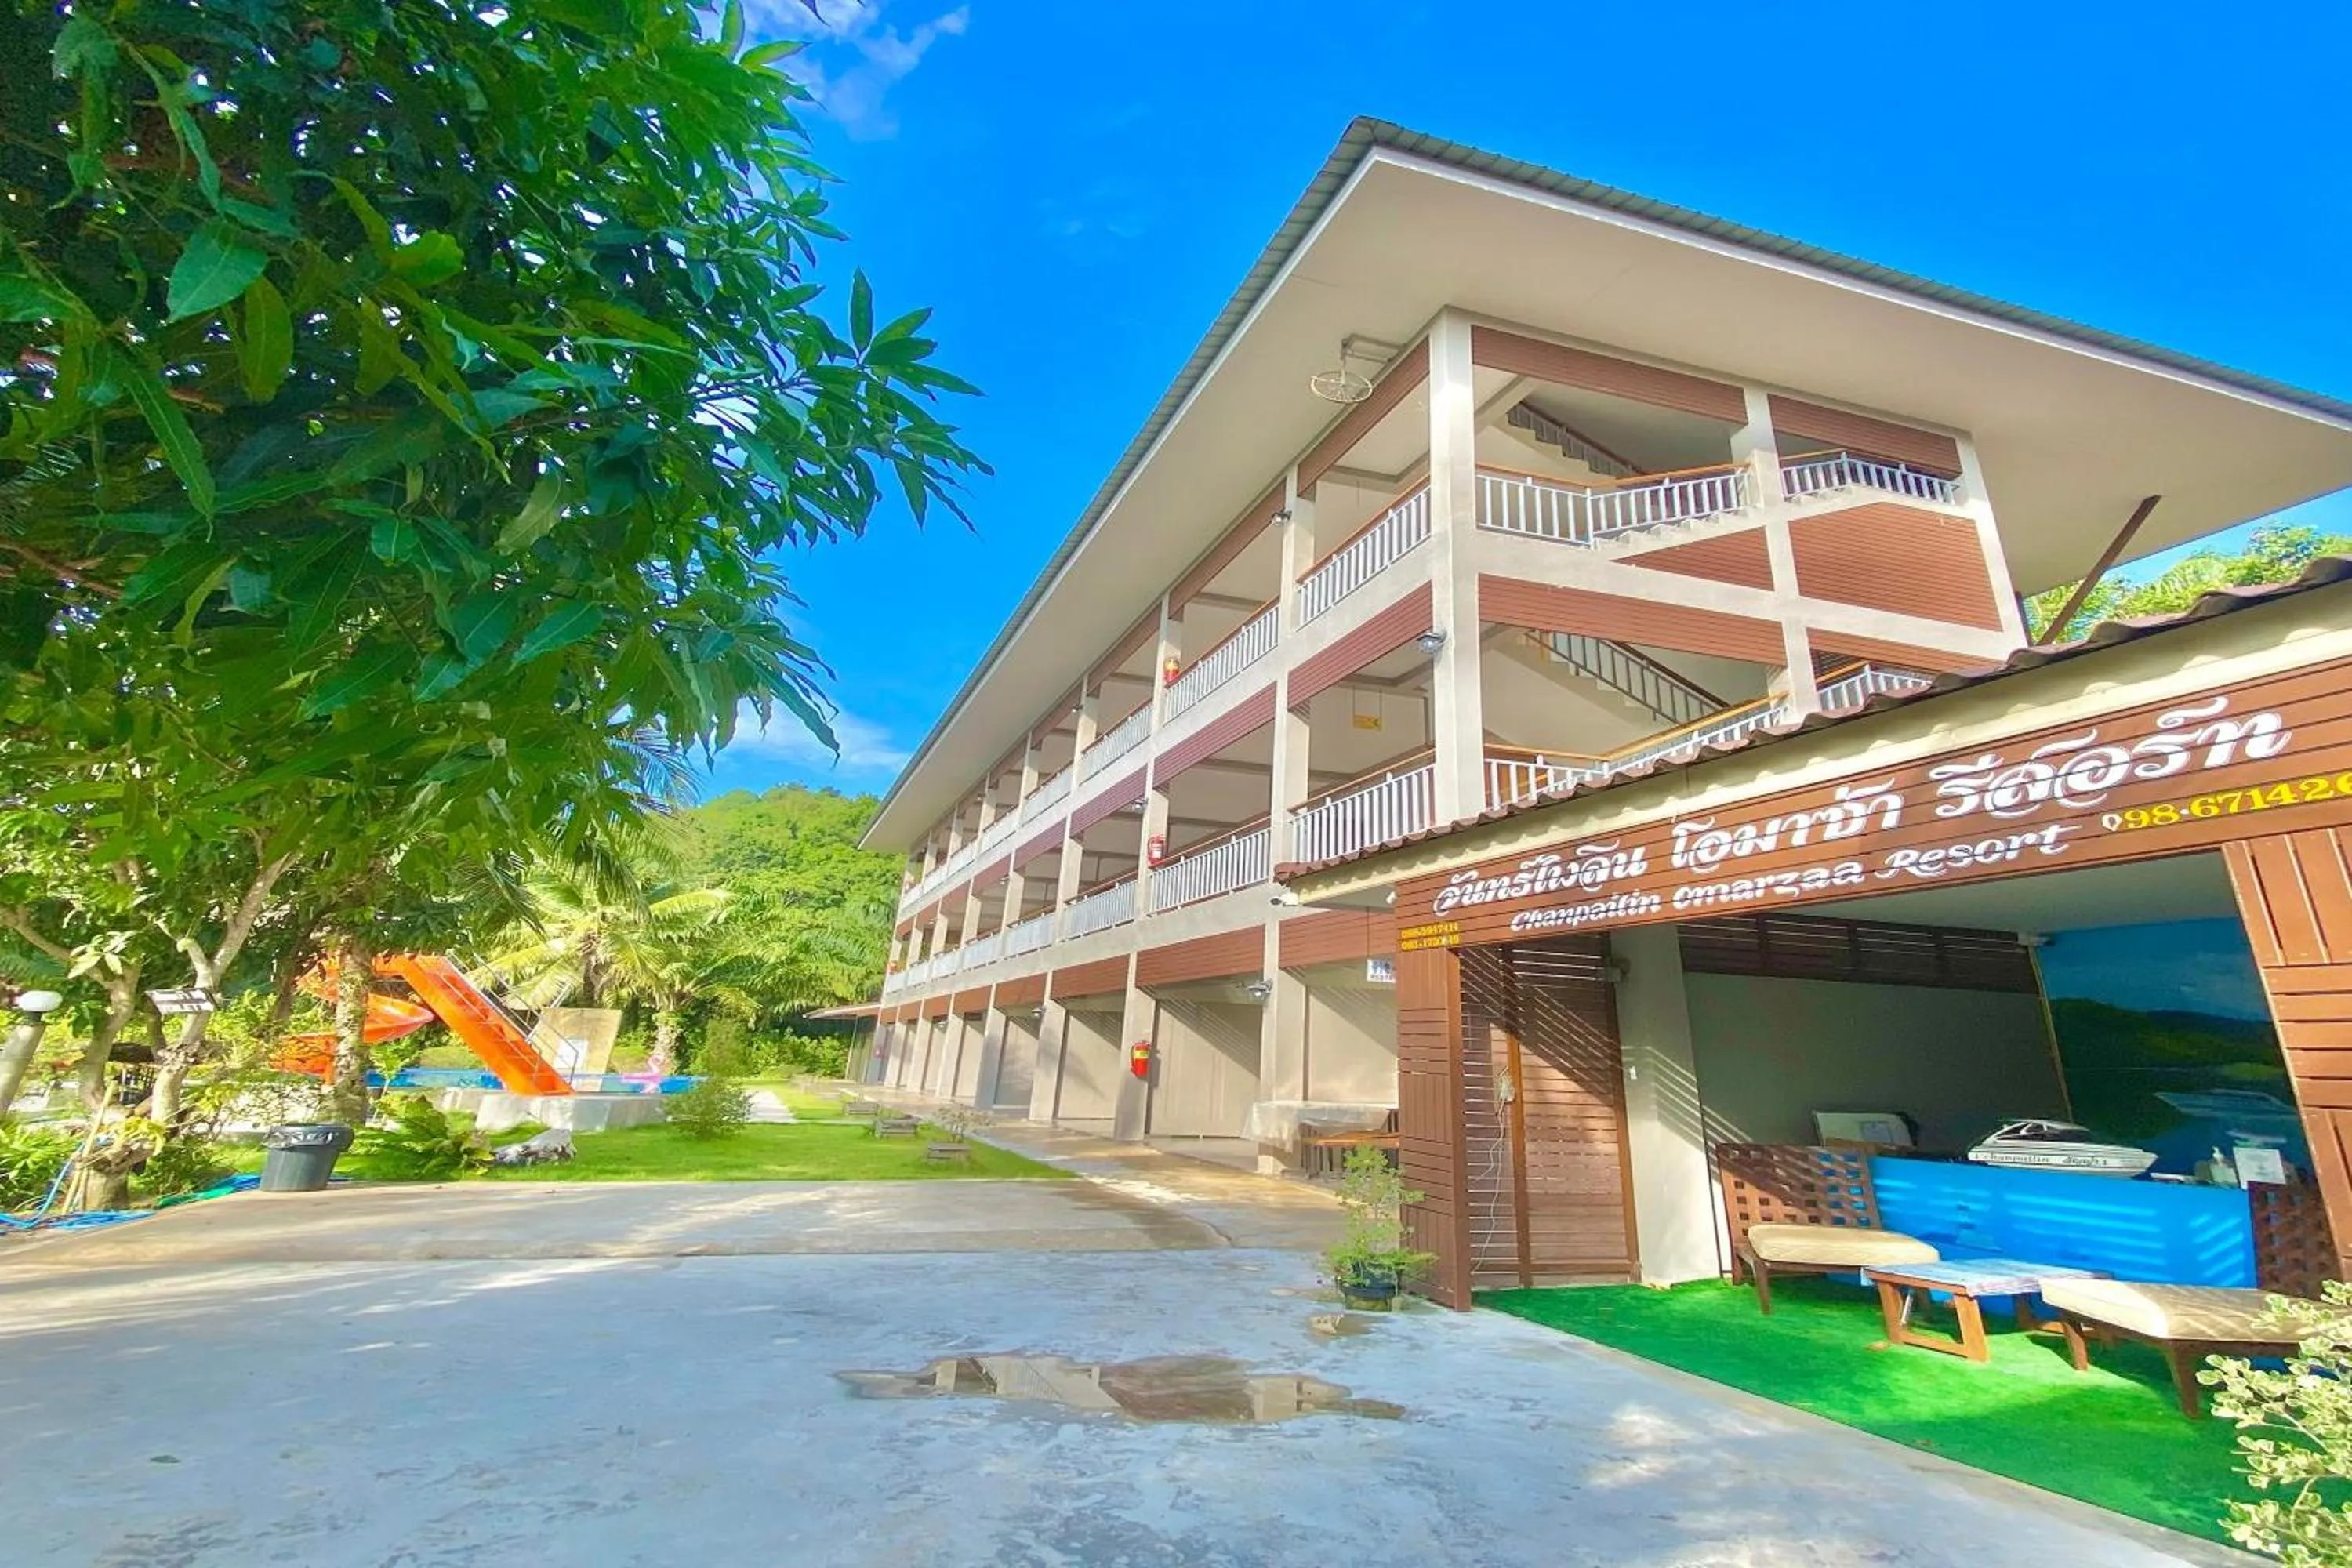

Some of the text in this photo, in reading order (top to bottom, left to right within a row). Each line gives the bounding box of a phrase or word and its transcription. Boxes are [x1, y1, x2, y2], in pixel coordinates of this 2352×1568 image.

[1928, 695, 2292, 818] รีสอร์ท
[1873, 824, 2083, 879] Resort
